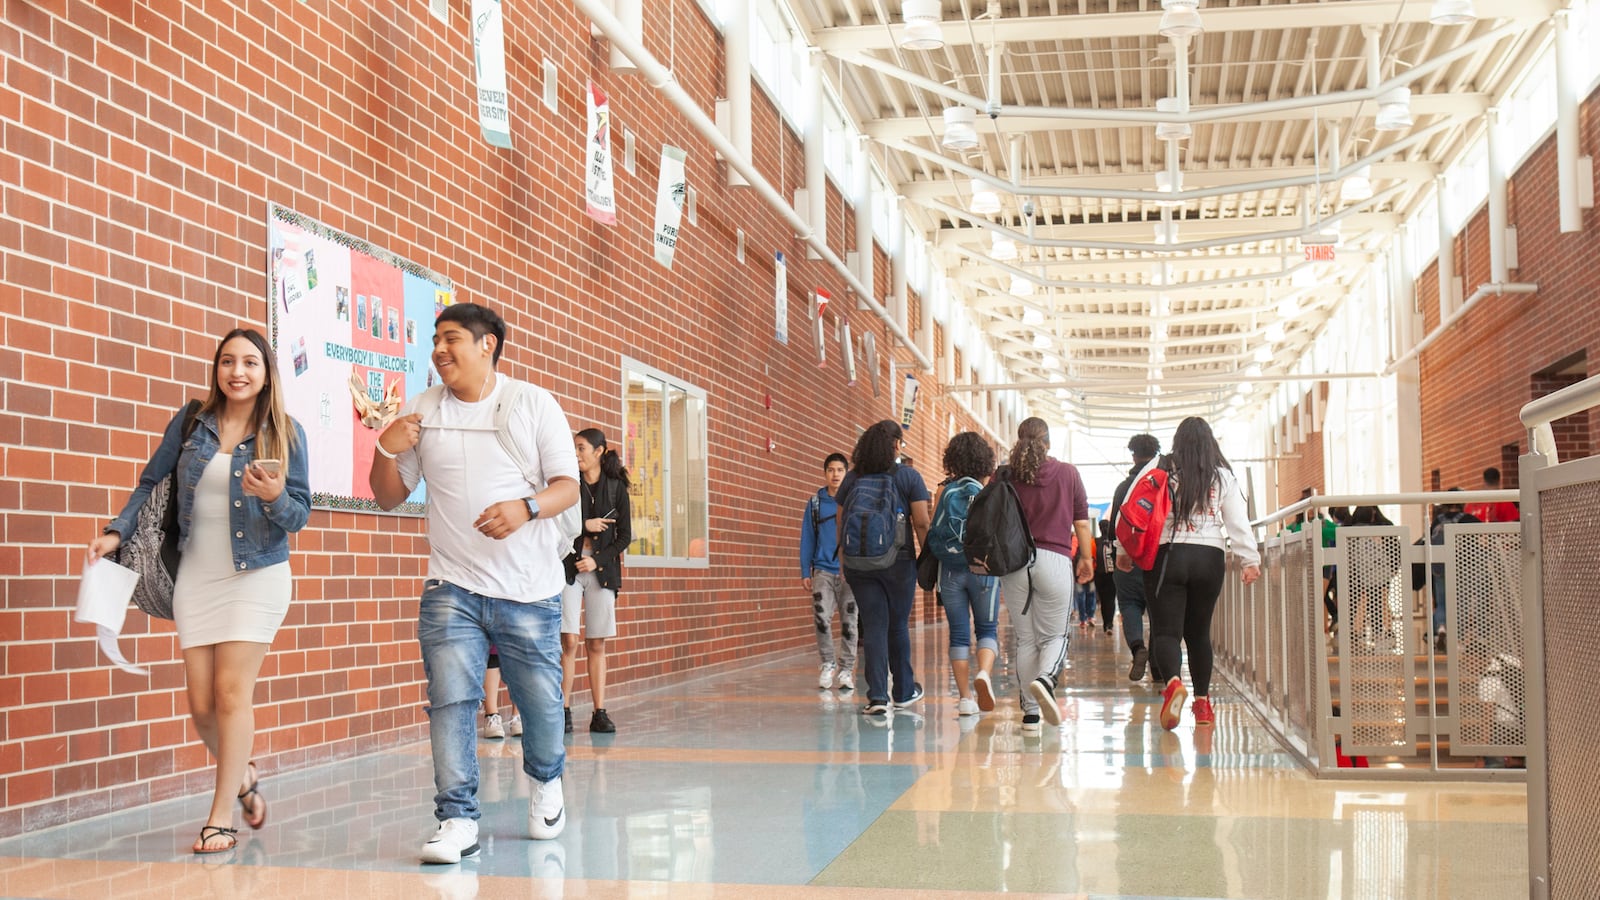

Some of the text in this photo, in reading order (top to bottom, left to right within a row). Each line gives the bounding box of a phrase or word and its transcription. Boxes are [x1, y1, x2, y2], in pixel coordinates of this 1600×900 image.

[1304, 245, 1336, 261] STAIRS
[326, 342, 367, 365] EVERYBODY
[378, 355, 407, 372] WELCOME
[369, 371, 382, 387] THE
[368, 387, 384, 402] NEST
